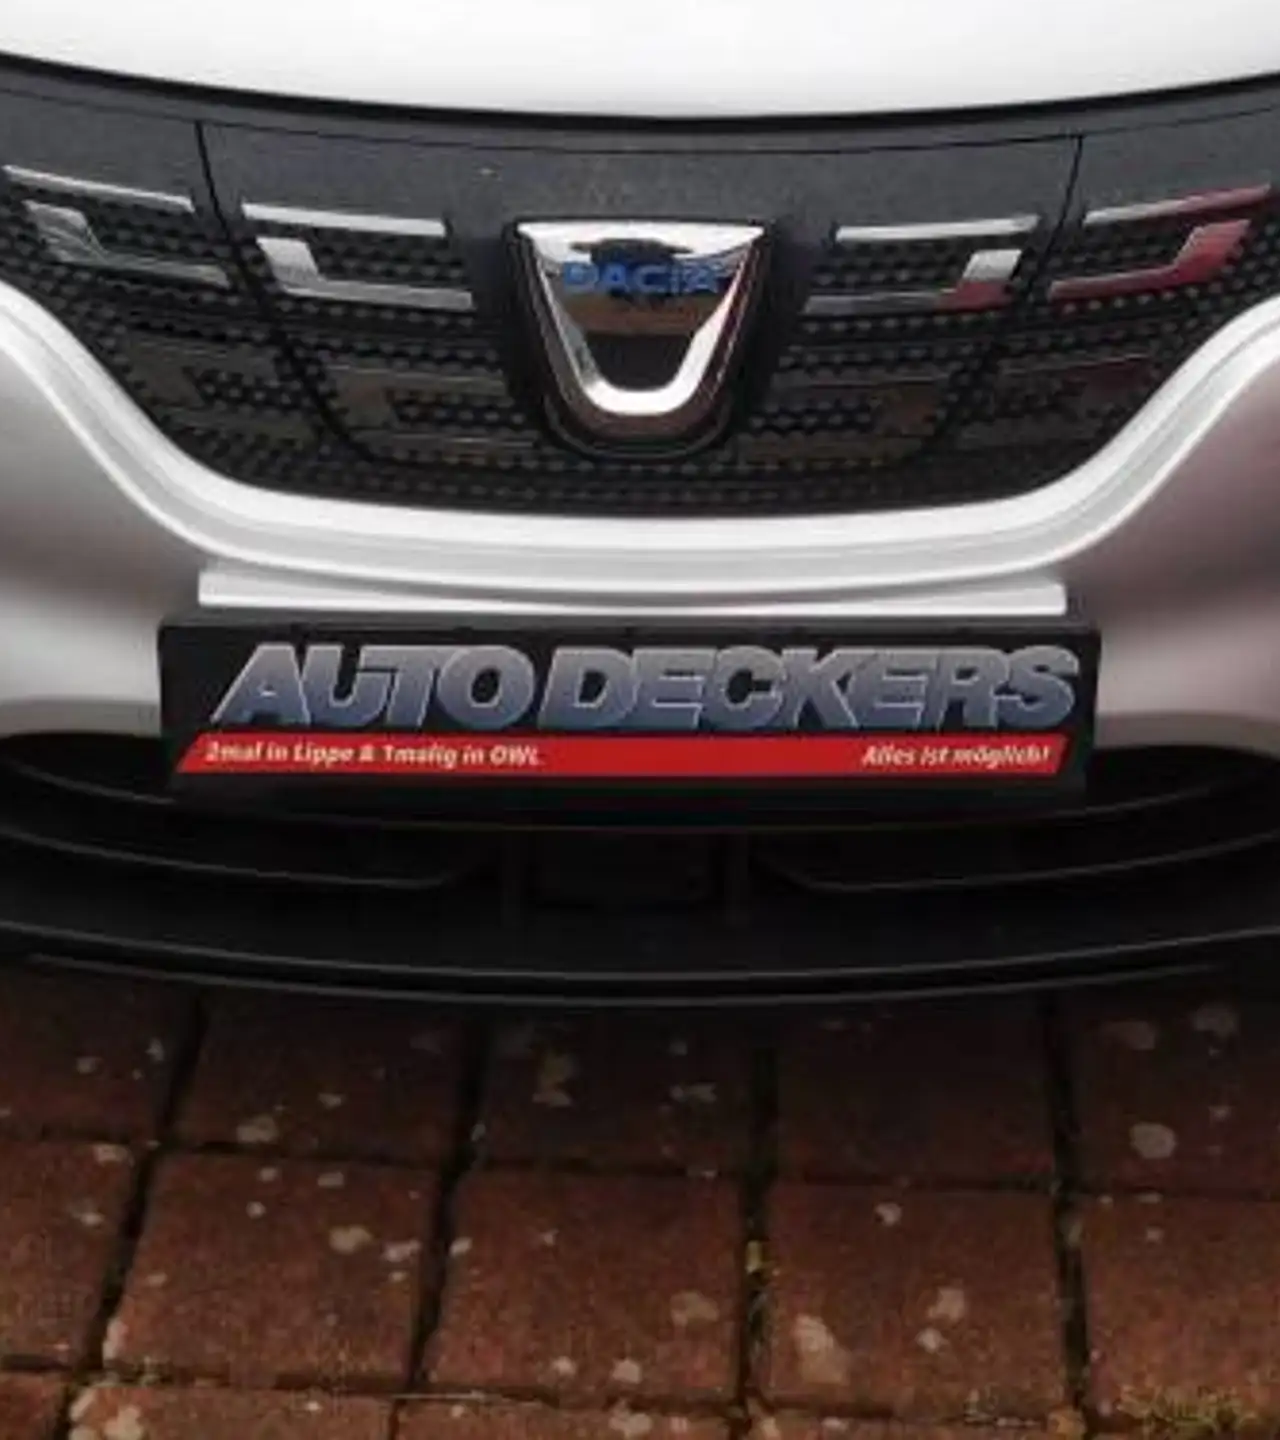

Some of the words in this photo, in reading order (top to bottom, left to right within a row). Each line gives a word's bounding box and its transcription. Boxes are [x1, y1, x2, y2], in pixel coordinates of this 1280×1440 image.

[563, 262, 718, 293] DACIA
[210, 642, 535, 729] AUTO
[538, 645, 1080, 729] DECKERS
[267, 741, 288, 762] in
[294, 741, 353, 768] Lippe
[462, 744, 484, 765] in
[861, 742, 916, 767] Alles
[920, 744, 948, 766] ist
